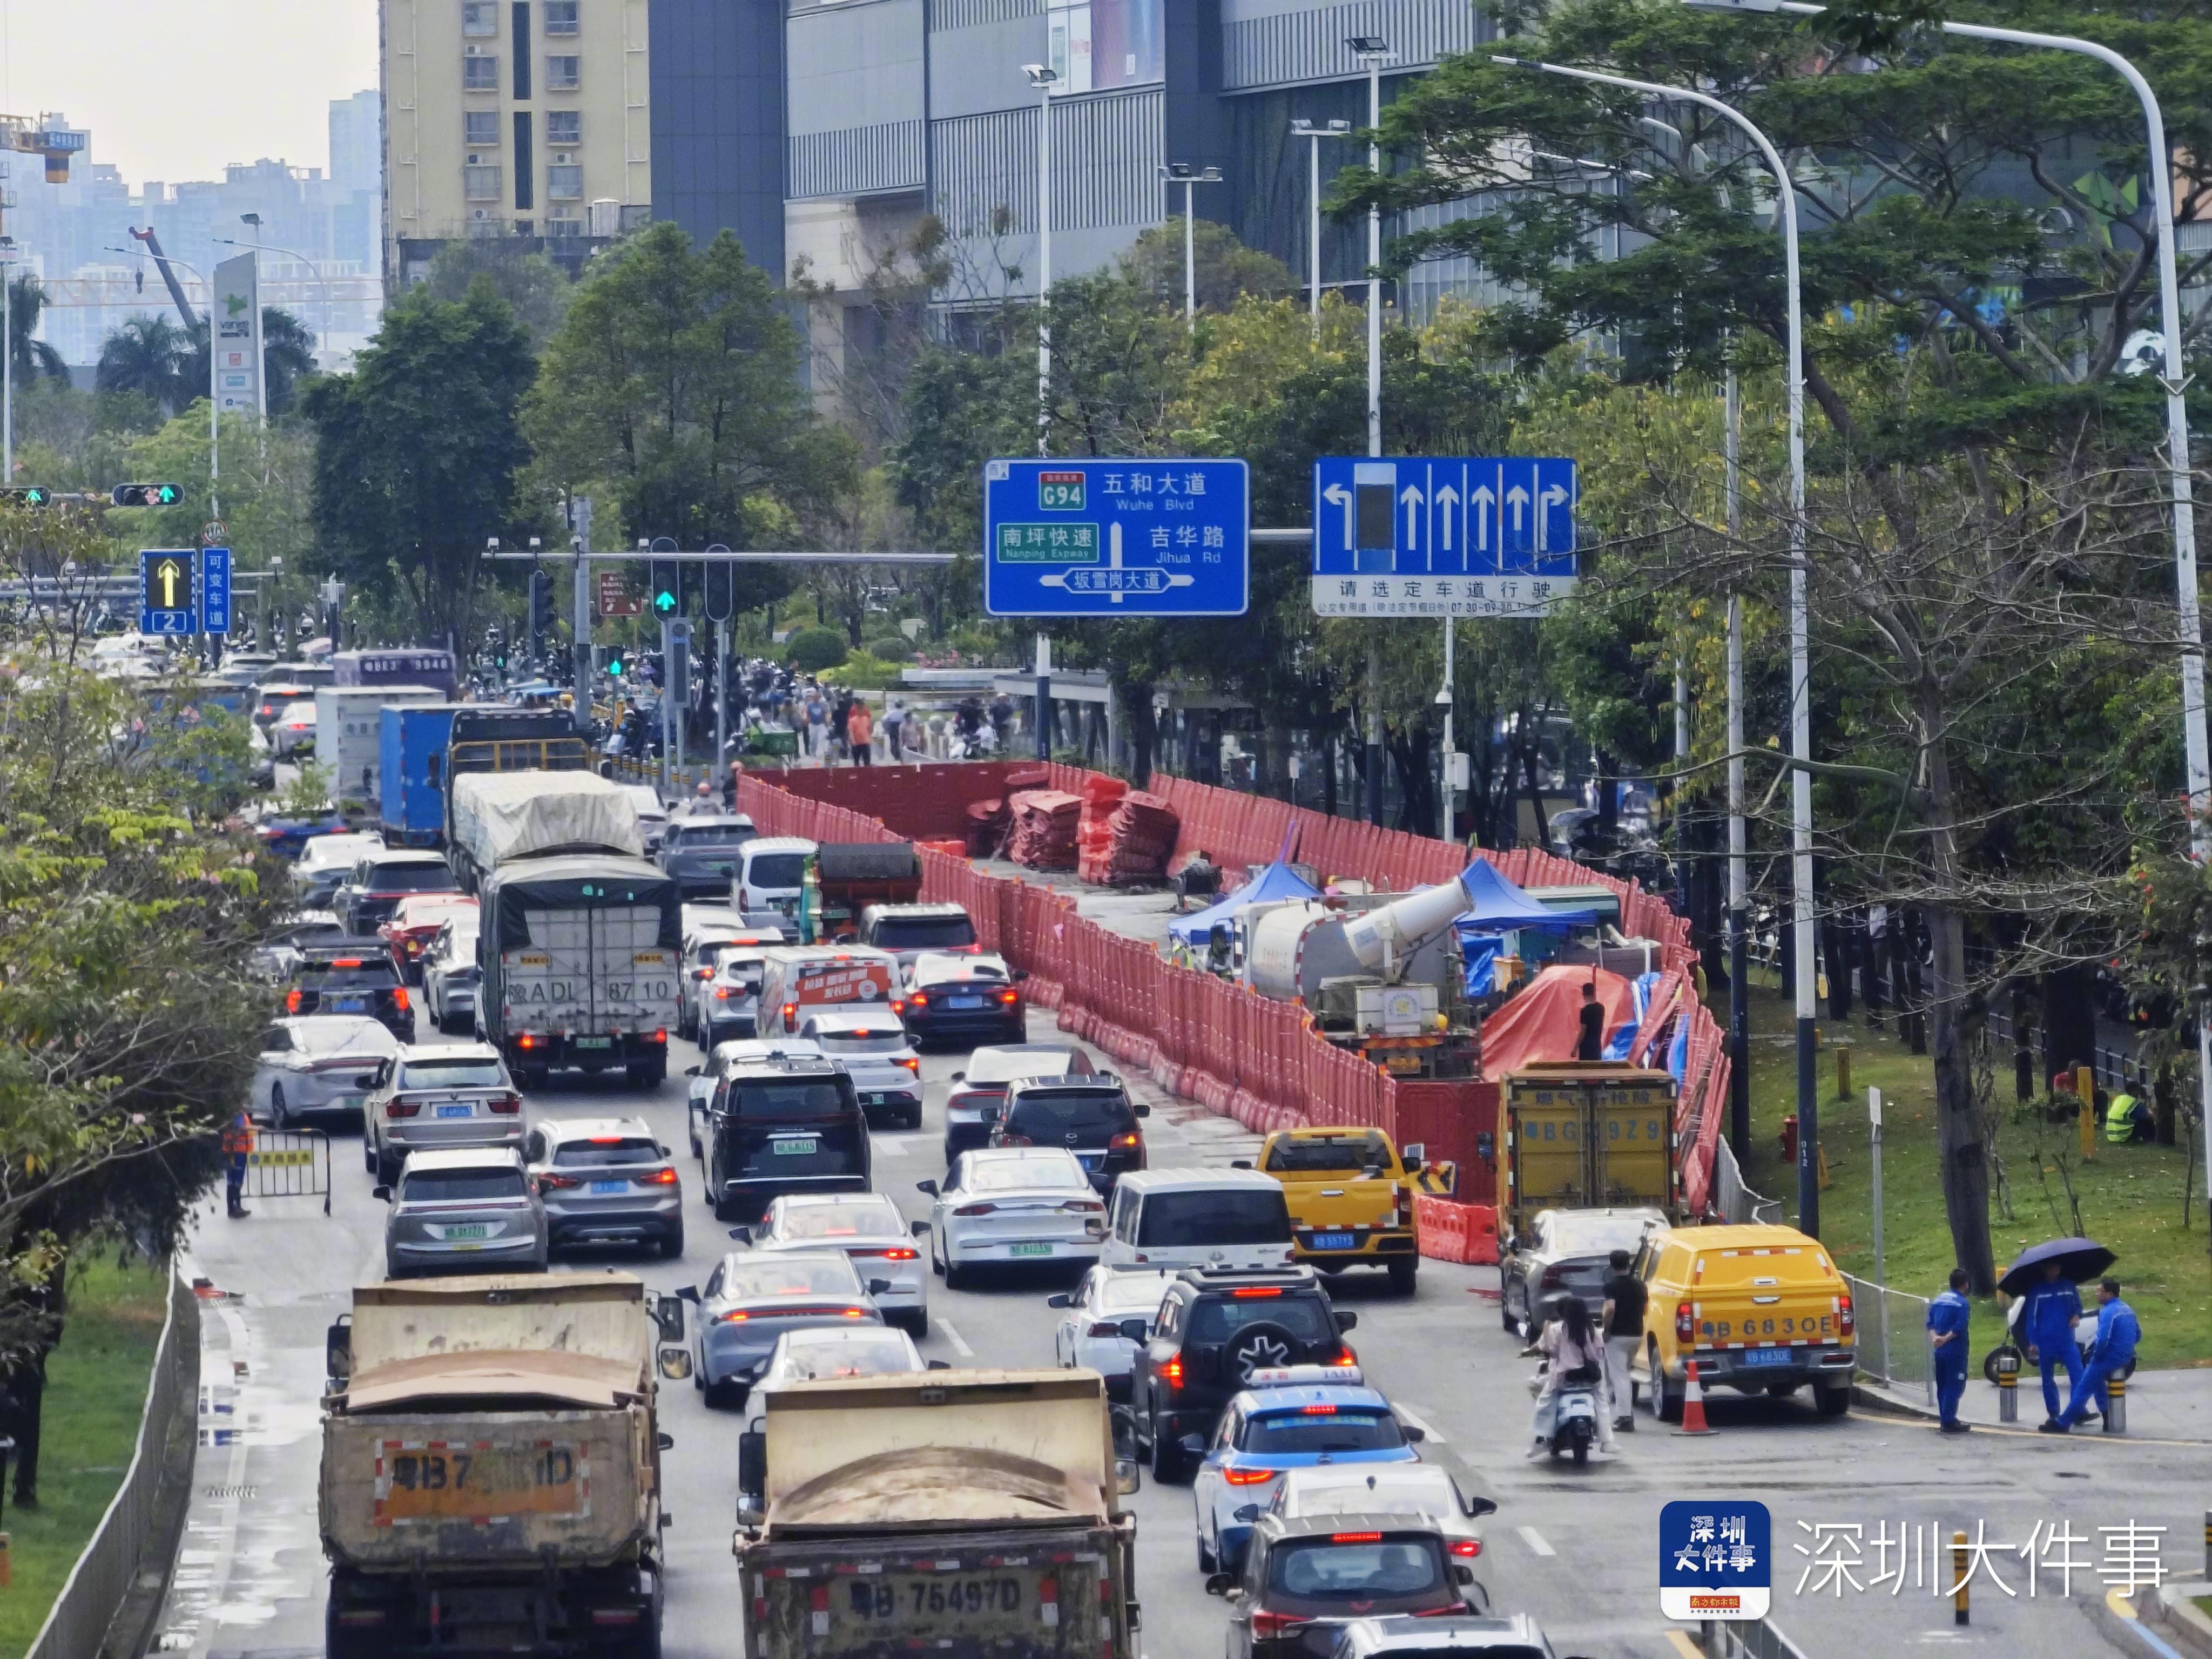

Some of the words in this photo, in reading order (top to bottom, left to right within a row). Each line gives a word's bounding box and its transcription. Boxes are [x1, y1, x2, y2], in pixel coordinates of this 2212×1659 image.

[1103, 473, 1207, 496] 五和大道
[1044, 486, 1081, 505] G94
[1117, 500, 1154, 511] Wuhe
[1165, 499, 1195, 511] Blvd
[1003, 528, 1093, 548] 南坪快速
[1150, 525, 1225, 549] 吉华路
[1006, 549, 1046, 559] Nanping
[1156, 551, 1191, 564] Jihua
[1203, 551, 1221, 564] Rd
[208, 555, 224, 625] 可变车道
[1074, 572, 1161, 590] 坂雪岗大道
[1339, 579, 1552, 598] 请选定车道行驶
[164, 613, 176, 631] 2
